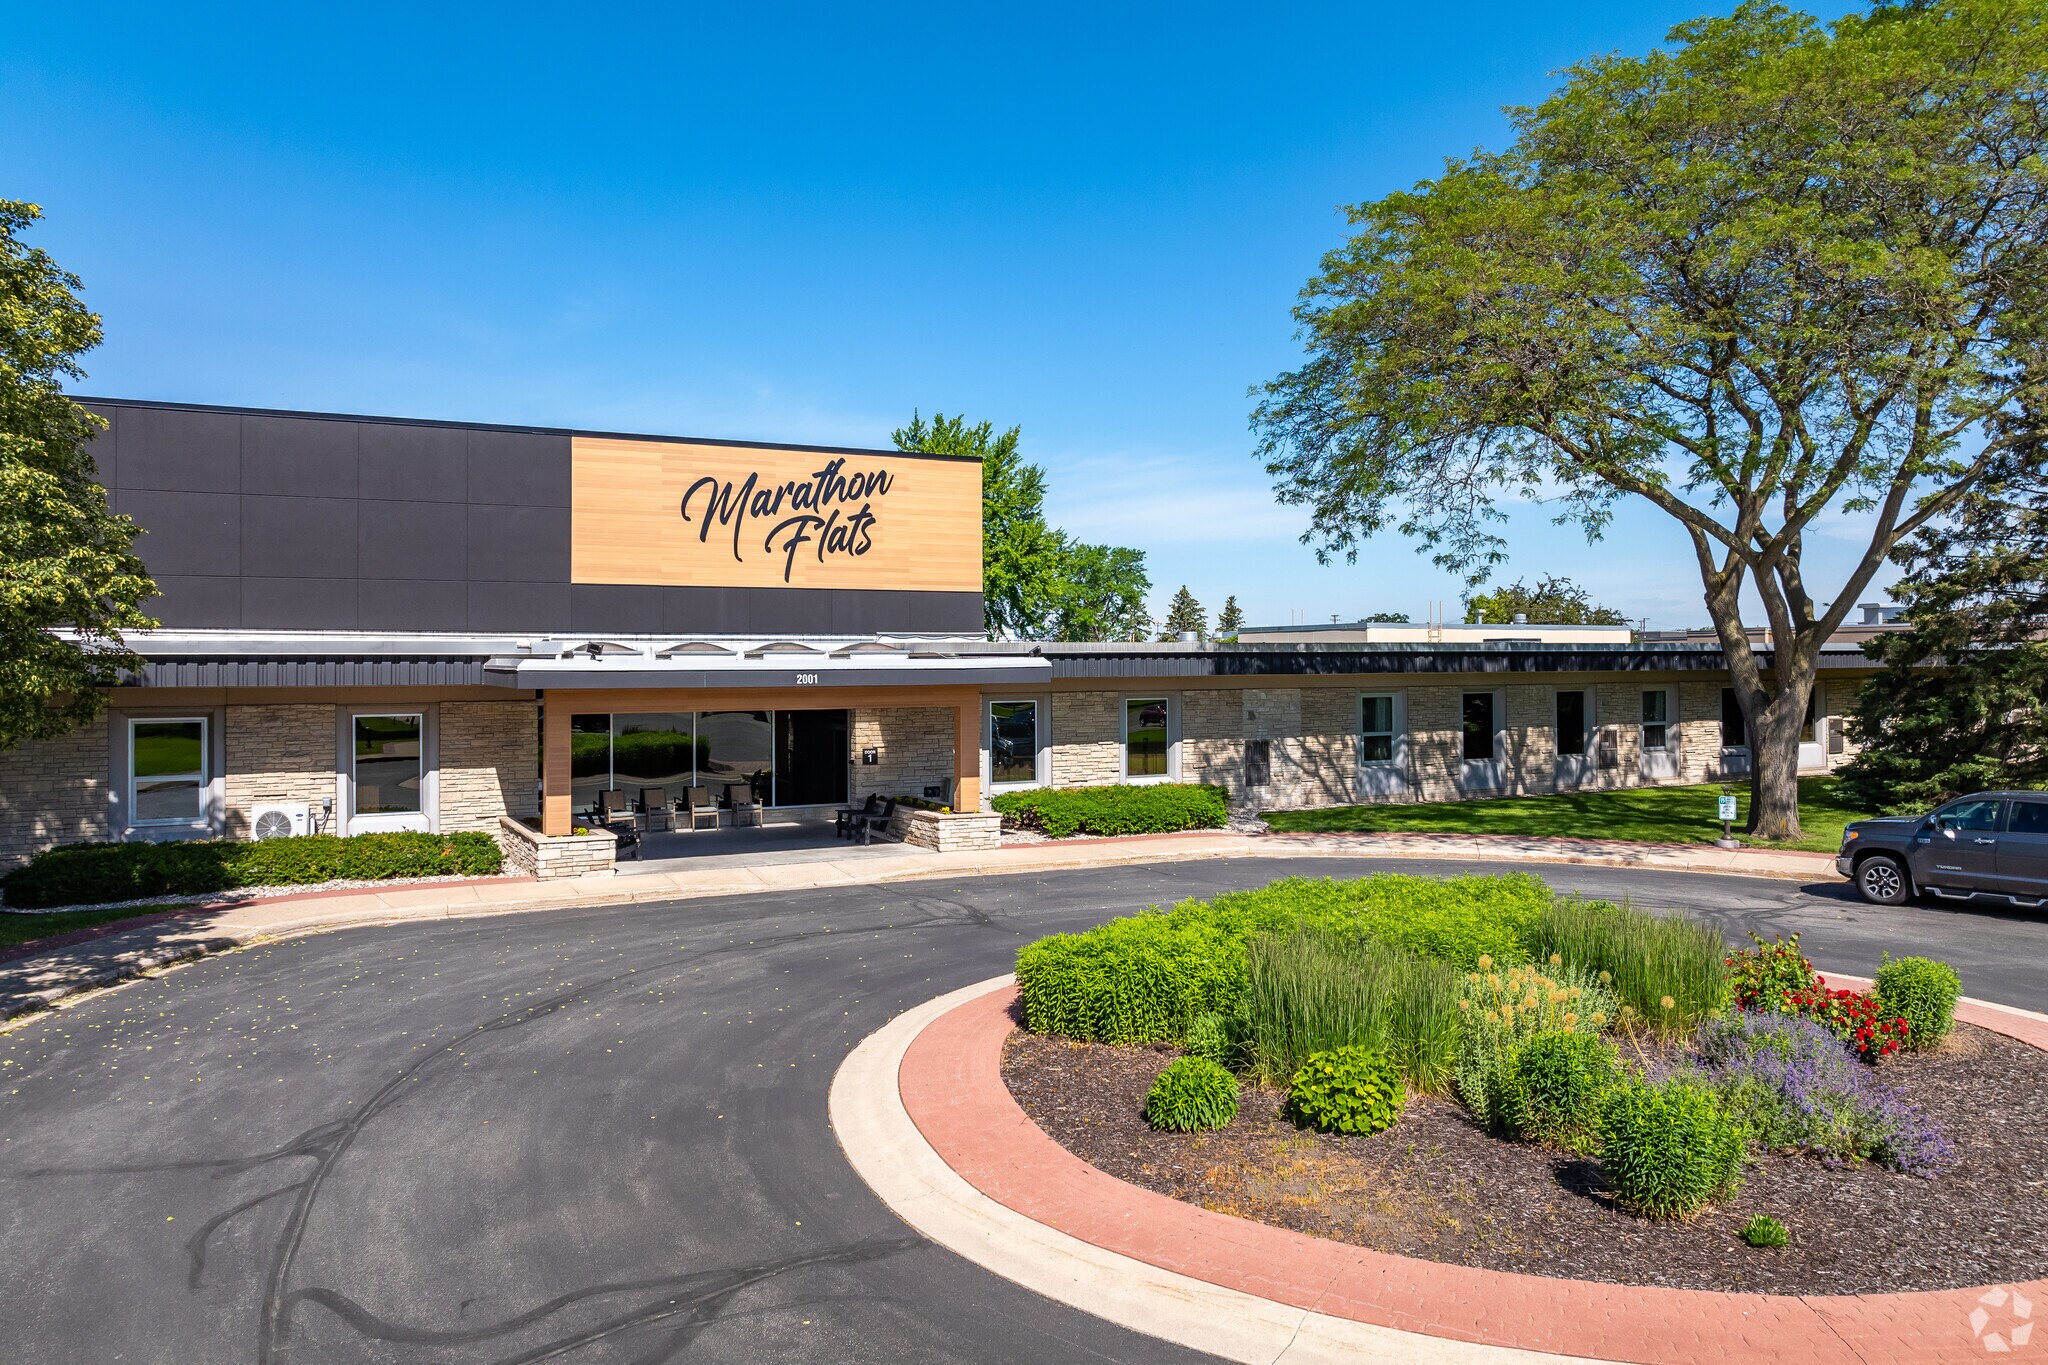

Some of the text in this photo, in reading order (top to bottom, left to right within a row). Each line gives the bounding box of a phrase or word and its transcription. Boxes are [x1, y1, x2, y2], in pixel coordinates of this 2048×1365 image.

[681, 457, 894, 562] Marathon
[764, 503, 876, 583] Flats
[796, 673, 818, 685] 2001
[867, 754, 872, 762] 1
